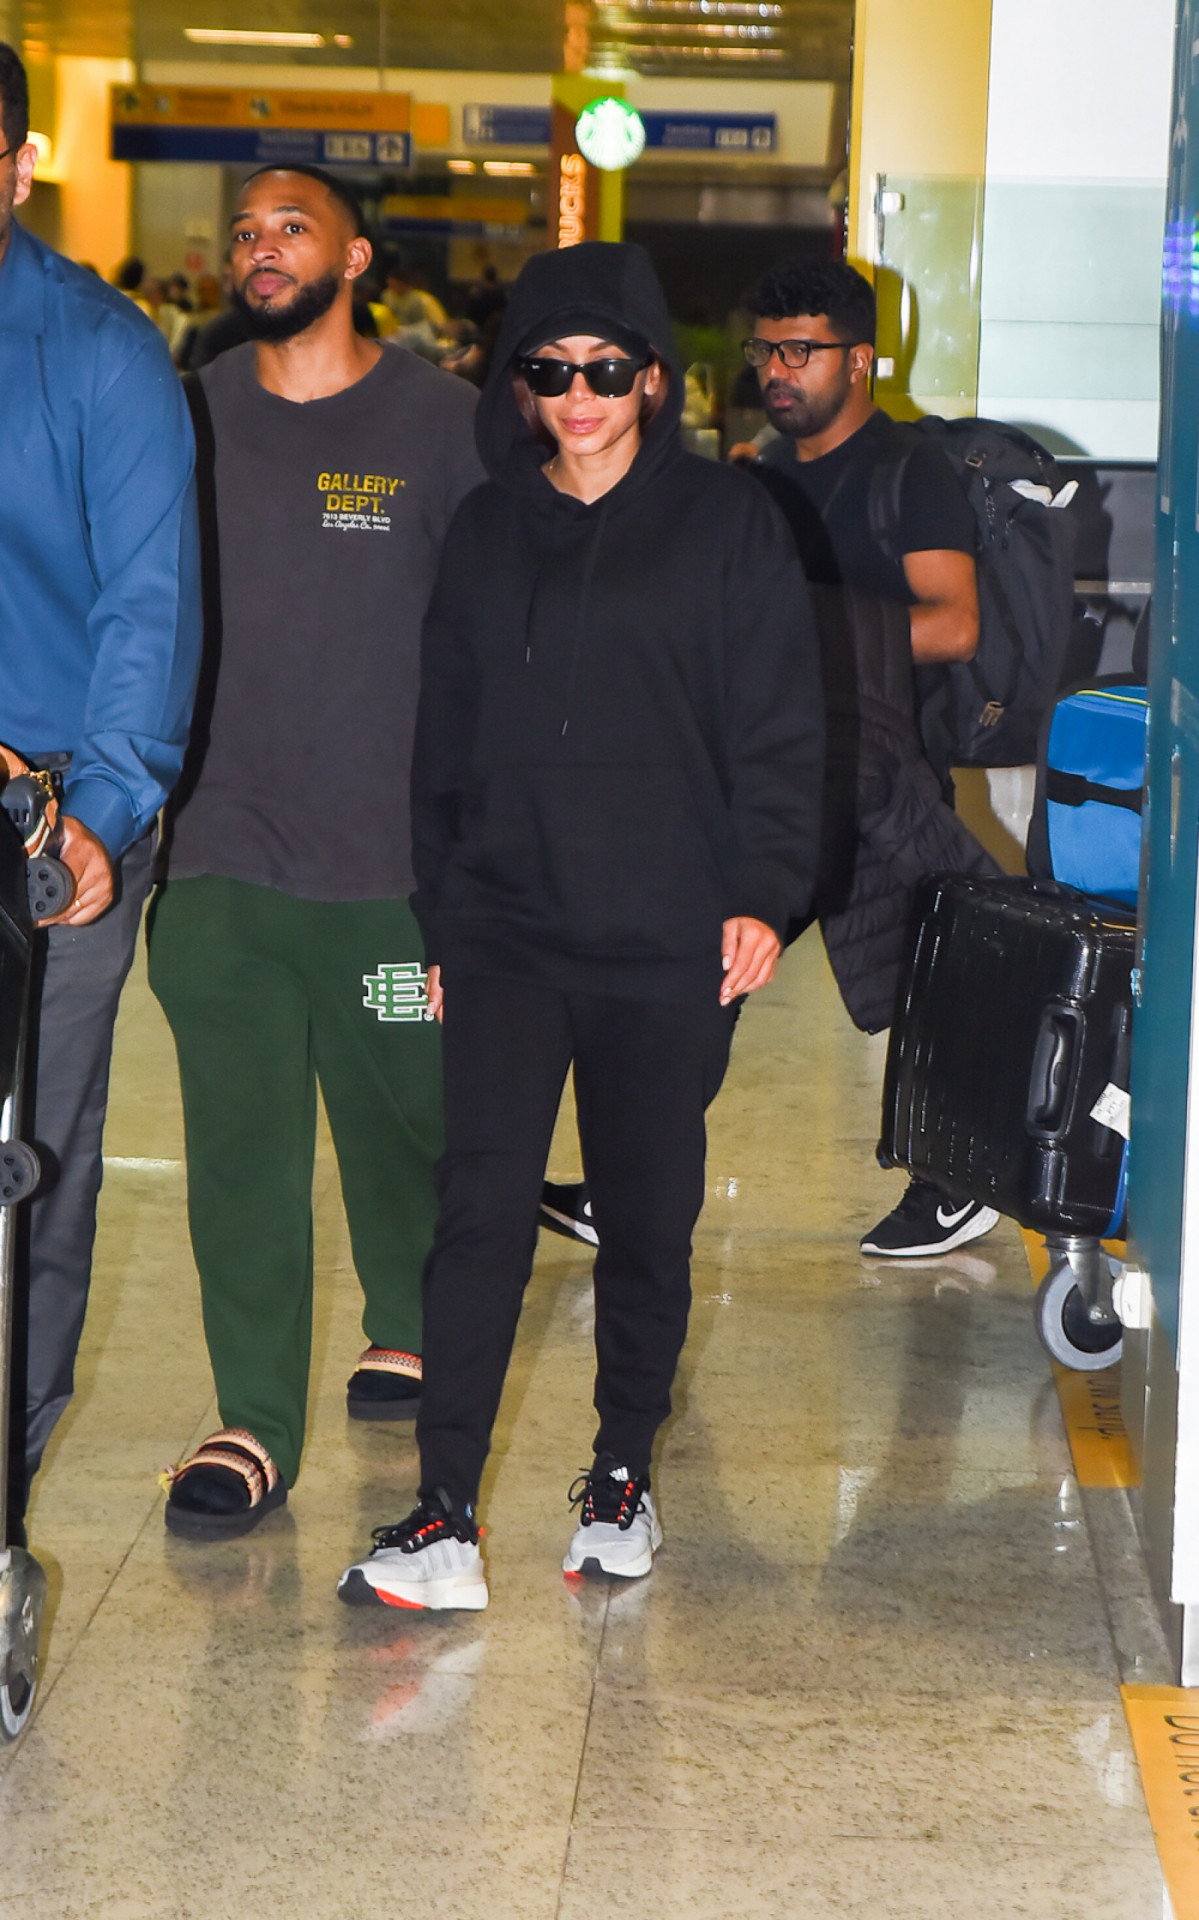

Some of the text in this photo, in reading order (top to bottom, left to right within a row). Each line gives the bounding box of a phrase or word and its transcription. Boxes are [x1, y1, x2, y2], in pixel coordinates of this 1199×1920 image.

[317, 472, 399, 496] GALLERY
[326, 494, 385, 514] DEPT.
[339, 513, 371, 521] BEVERLY
[372, 515, 391, 524] BLVD
